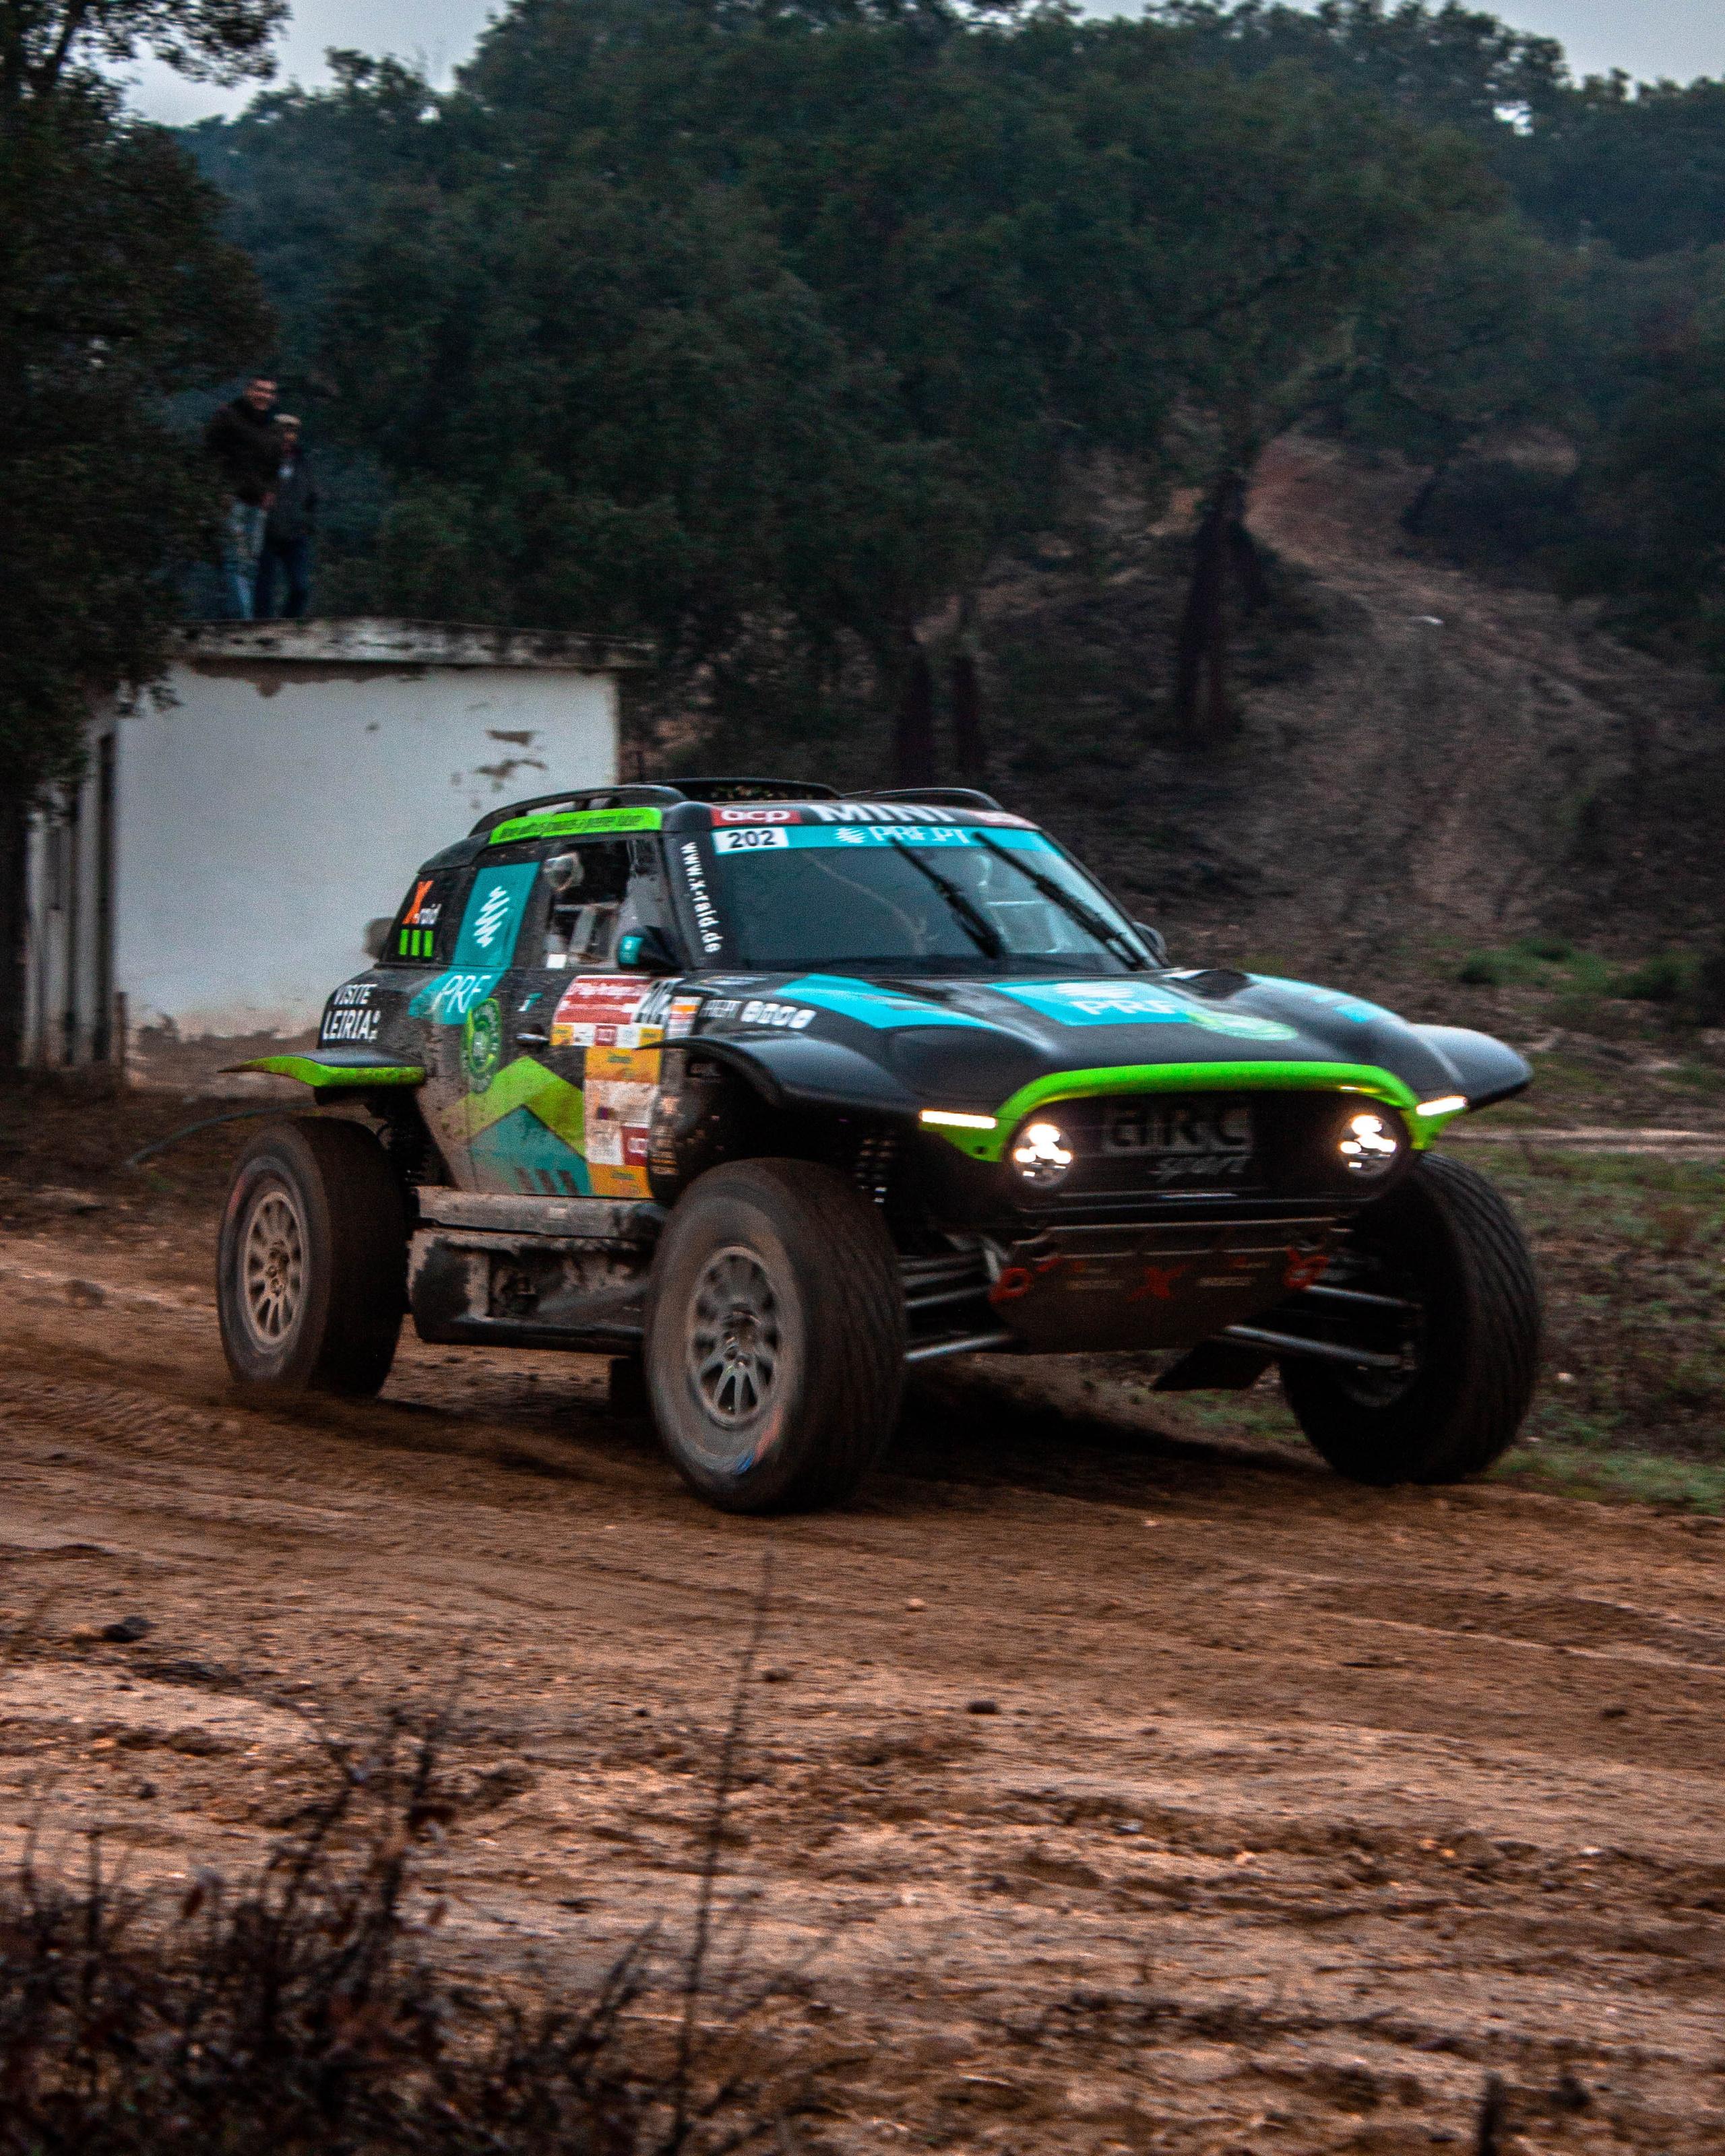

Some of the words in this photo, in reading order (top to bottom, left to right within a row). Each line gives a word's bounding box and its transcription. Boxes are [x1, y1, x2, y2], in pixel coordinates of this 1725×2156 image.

[809, 804, 955, 821] MINI
[728, 829, 777, 848] 202
[680, 842, 723, 953] www.x-raid.de
[427, 975, 492, 1013] PRF
[1070, 999, 1178, 1015] PRF
